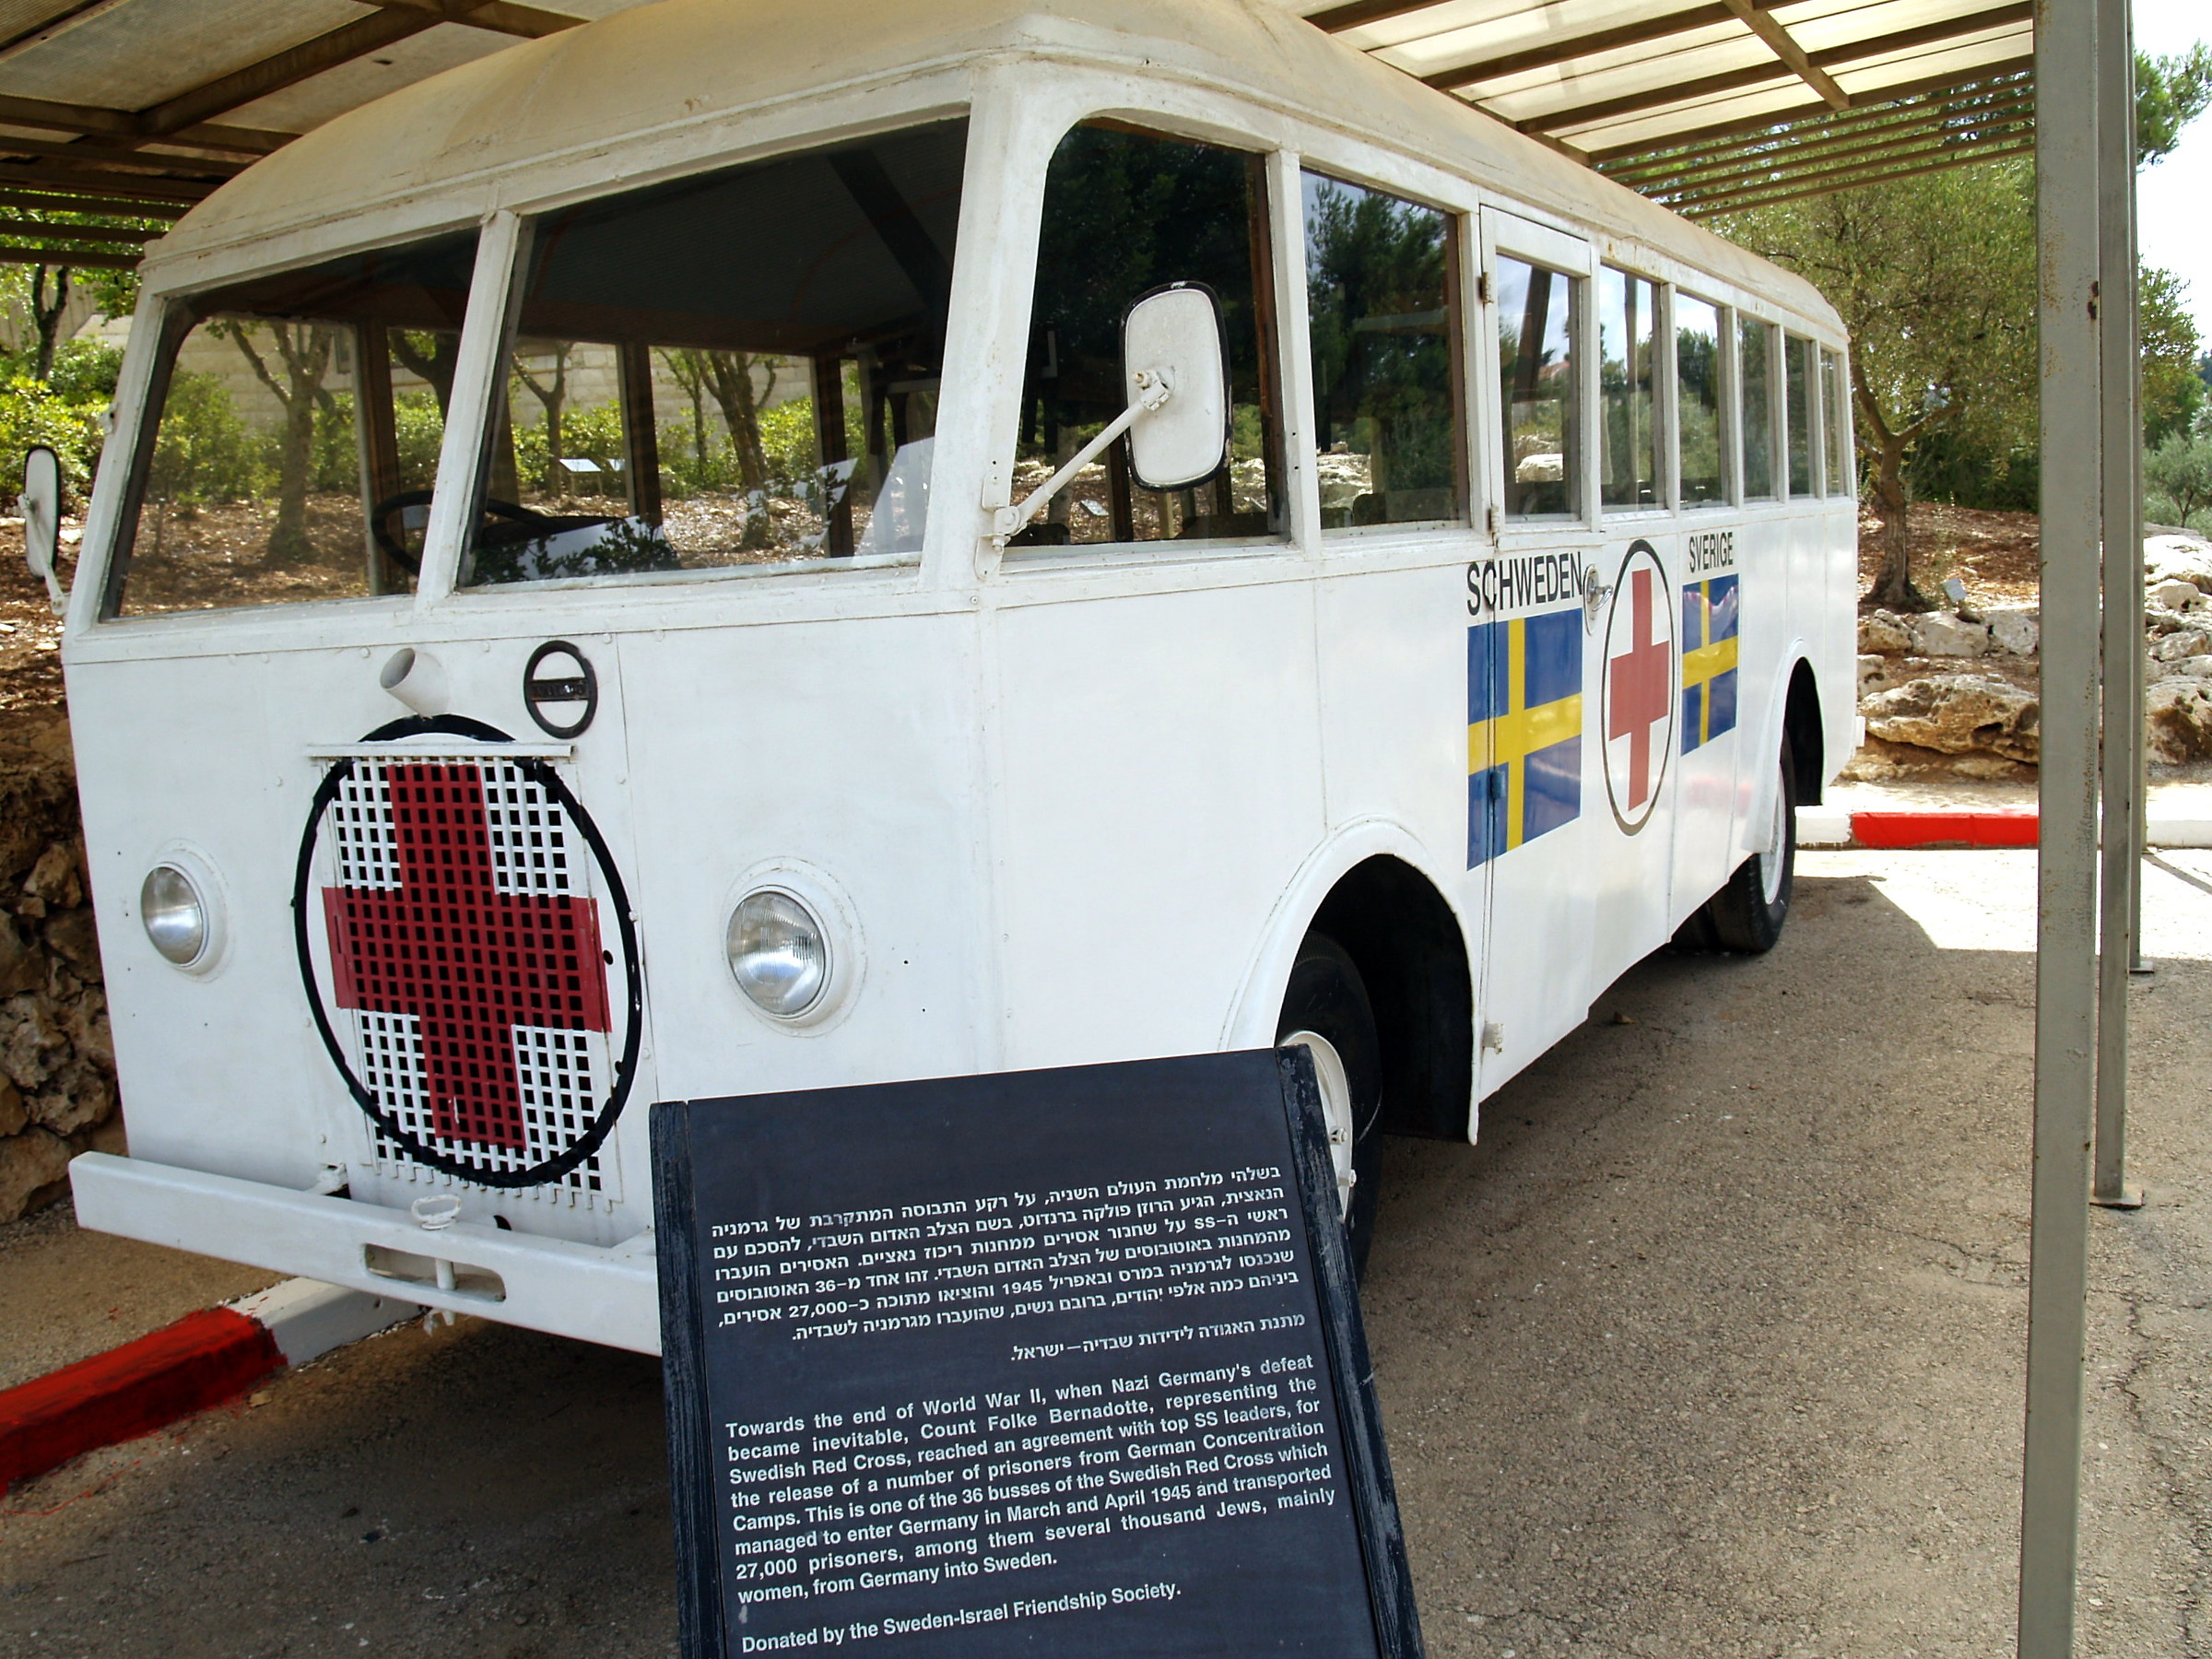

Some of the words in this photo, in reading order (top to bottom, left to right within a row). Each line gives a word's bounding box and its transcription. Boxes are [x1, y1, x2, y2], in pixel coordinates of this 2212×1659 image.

[1688, 531, 1734, 573] SVERIGE
[1466, 550, 1583, 616] SCHWEDEN
[1163, 1171, 1224, 1191] מלחמת
[1230, 1166, 1281, 1182] בשלהי
[1044, 1186, 1100, 1206] השניה,
[1106, 1181, 1157, 1197] העולם
[1221, 1187, 1285, 1207] הנאצית,
[900, 1200, 968, 1218] התבוסה
[974, 1196, 1008, 1213] רקע
[1014, 1192, 1036, 1207] על
[1136, 1199, 1174, 1218] הרוזן
[1179, 1194, 1216, 1212] הגיע
[808, 1207, 894, 1228] המתקרבת
[1018, 1210, 1077, 1230] ברנדוט,
[1081, 1203, 1132, 1223] פולקה
[1247, 1207, 1288, 1223] ראשי
[711, 1220, 769, 1238] גרמניה
[775, 1216, 801, 1231] של
[925, 1221, 970, 1238] הצלב
[975, 1218, 1014, 1232] בשם
[1164, 1218, 1186, 1234] על
[806, 1232, 865, 1252] השבדי,
[870, 1227, 921, 1243] האדום
[1043, 1229, 1100, 1247] אסירים
[1218, 1229, 1291, 1249] מהמחנות
[712, 1244, 738, 1260] עם
[744, 1236, 801, 1256] להסכם
[924, 1244, 963, 1260] ריכוז
[971, 1236, 1035, 1255] ממחנות
[1094, 1247, 1120, 1263] של
[1124, 1239, 1213, 1260] באוטובוסים
[779, 1256, 850, 1275] האסירים
[857, 1249, 916, 1266] נאציים.
[994, 1257, 1044, 1275] האדום
[1048, 1252, 1091, 1268] הצלב
[1170, 1254, 1232, 1277] לגרמניה
[1239, 1249, 1295, 1268] שנכנסו
[714, 1264, 771, 1282] הועברו
[865, 1272, 900, 1288] אחד
[904, 1269, 929, 1284] זהו
[934, 1264, 989, 1281] השבדי.
[1048, 1271, 1112, 1290] ובאפריל
[1118, 1265, 1165, 1282] במרס
[1248, 1271, 1300, 1288] ביניהם
[716, 1282, 810, 1304] האוטובוסים
[937, 1285, 994, 1302] והוציאו
[1002, 1279, 1043, 1295] 1945
[1168, 1281, 1206, 1298] אלפי
[1209, 1278, 1244, 1294] כמה
[876, 1291, 931, 1310] מתוכה
[1009, 1300, 1054, 1319] נשים,
[1059, 1294, 1107, 1312] ברובם
[718, 1307, 782, 1328] אסירים,
[863, 1313, 932, 1333] מגרמניה
[936, 1305, 1005, 1325] שהועברו
[1259, 1313, 1306, 1331] מתנת
[792, 1319, 858, 1341] לשבדיה.
[1137, 1324, 1194, 1347] לידידות
[1197, 1320, 1255, 1339] האגודה
[724, 1416, 806, 1439] Towards
[813, 1412, 843, 1429] the
[853, 1406, 887, 1425] end
[896, 1402, 914, 1419] of
[922, 1394, 977, 1417] World
[984, 1392, 1021, 1409] War
[1030, 1387, 1047, 1406] II,
[1054, 1383, 1103, 1401] when
[1111, 1374, 1149, 1394] Nazi
[1158, 1363, 1252, 1388] Germany's
[1260, 1354, 1314, 1375] defeat
[727, 1441, 800, 1462] became
[812, 1428, 909, 1453] inevitable,
[920, 1418, 977, 1440] Count
[987, 1412, 1038, 1431] Folke
[1049, 1399, 1154, 1424] Bernadotte,
[1165, 1383, 1278, 1411] representing
[1288, 1377, 1317, 1394] the
[729, 1461, 806, 1485] Swedish
[812, 1456, 847, 1476] Red
[853, 1453, 912, 1471] Cross,
[917, 1440, 988, 1463] reached
[994, 1440, 1016, 1453] an
[1021, 1425, 1114, 1453] agreement
[1118, 1419, 1155, 1438] with
[1159, 1418, 1189, 1435] top
[1194, 1411, 1218, 1429] SS
[1223, 1405, 1291, 1424] leaders,
[1295, 1399, 1321, 1415] for
[730, 1491, 760, 1509] the
[768, 1485, 834, 1504] release
[841, 1477, 860, 1496] of
[867, 1479, 878, 1492] a
[886, 1469, 955, 1490] number
[961, 1463, 981, 1481] of
[987, 1455, 1072, 1482] prisoners
[1078, 1450, 1121, 1466] from
[1127, 1440, 1196, 1460] German
[1203, 1421, 1324, 1450] Concentration
[733, 1512, 801, 1532] Camps.
[804, 1504, 844, 1524] This
[848, 1502, 865, 1519] is
[869, 1500, 903, 1515] one
[907, 1493, 925, 1511] of
[928, 1491, 958, 1508] the
[961, 1487, 983, 1504] 36
[987, 1481, 1051, 1501] busses
[1054, 1475, 1073, 1492] of
[1076, 1473, 1105, 1489] the
[1108, 1462, 1182, 1486] Swedish
[1185, 1455, 1219, 1476] Red
[1223, 1453, 1275, 1470] Cross
[1277, 1441, 1328, 1463] which
[735, 1530, 818, 1557] managed
[822, 1530, 841, 1546] to
[847, 1524, 893, 1542] enter
[899, 1513, 979, 1535] Germany
[984, 1509, 1002, 1525] in
[1006, 1500, 1061, 1523] March
[1065, 1495, 1099, 1514] and
[1104, 1488, 1146, 1512] April
[1150, 1483, 1192, 1503] 1945
[1196, 1477, 1229, 1498] and
[1232, 1463, 1332, 1492] transported
[735, 1558, 797, 1581] 27,000
[808, 1548, 904, 1575] prisoners,
[914, 1538, 978, 1559] among
[987, 1531, 1034, 1548] them
[1044, 1517, 1112, 1541] several
[1120, 1504, 1206, 1531] thousand
[1216, 1500, 1267, 1518] Jews,
[1277, 1487, 1335, 1510] mainly
[737, 1584, 809, 1605] women,
[812, 1578, 855, 1595] from
[859, 1567, 940, 1589] Germany
[944, 1560, 979, 1579] into
[982, 1551, 1058, 1573] Sweden.
[741, 1628, 818, 1653] Donated
[822, 1626, 845, 1646] by
[849, 1622, 879, 1640] the
[883, 1603, 1009, 1635] Sweden-Israel
[1013, 1591, 1108, 1618] Friendship
[1111, 1582, 1182, 1605] Society.
